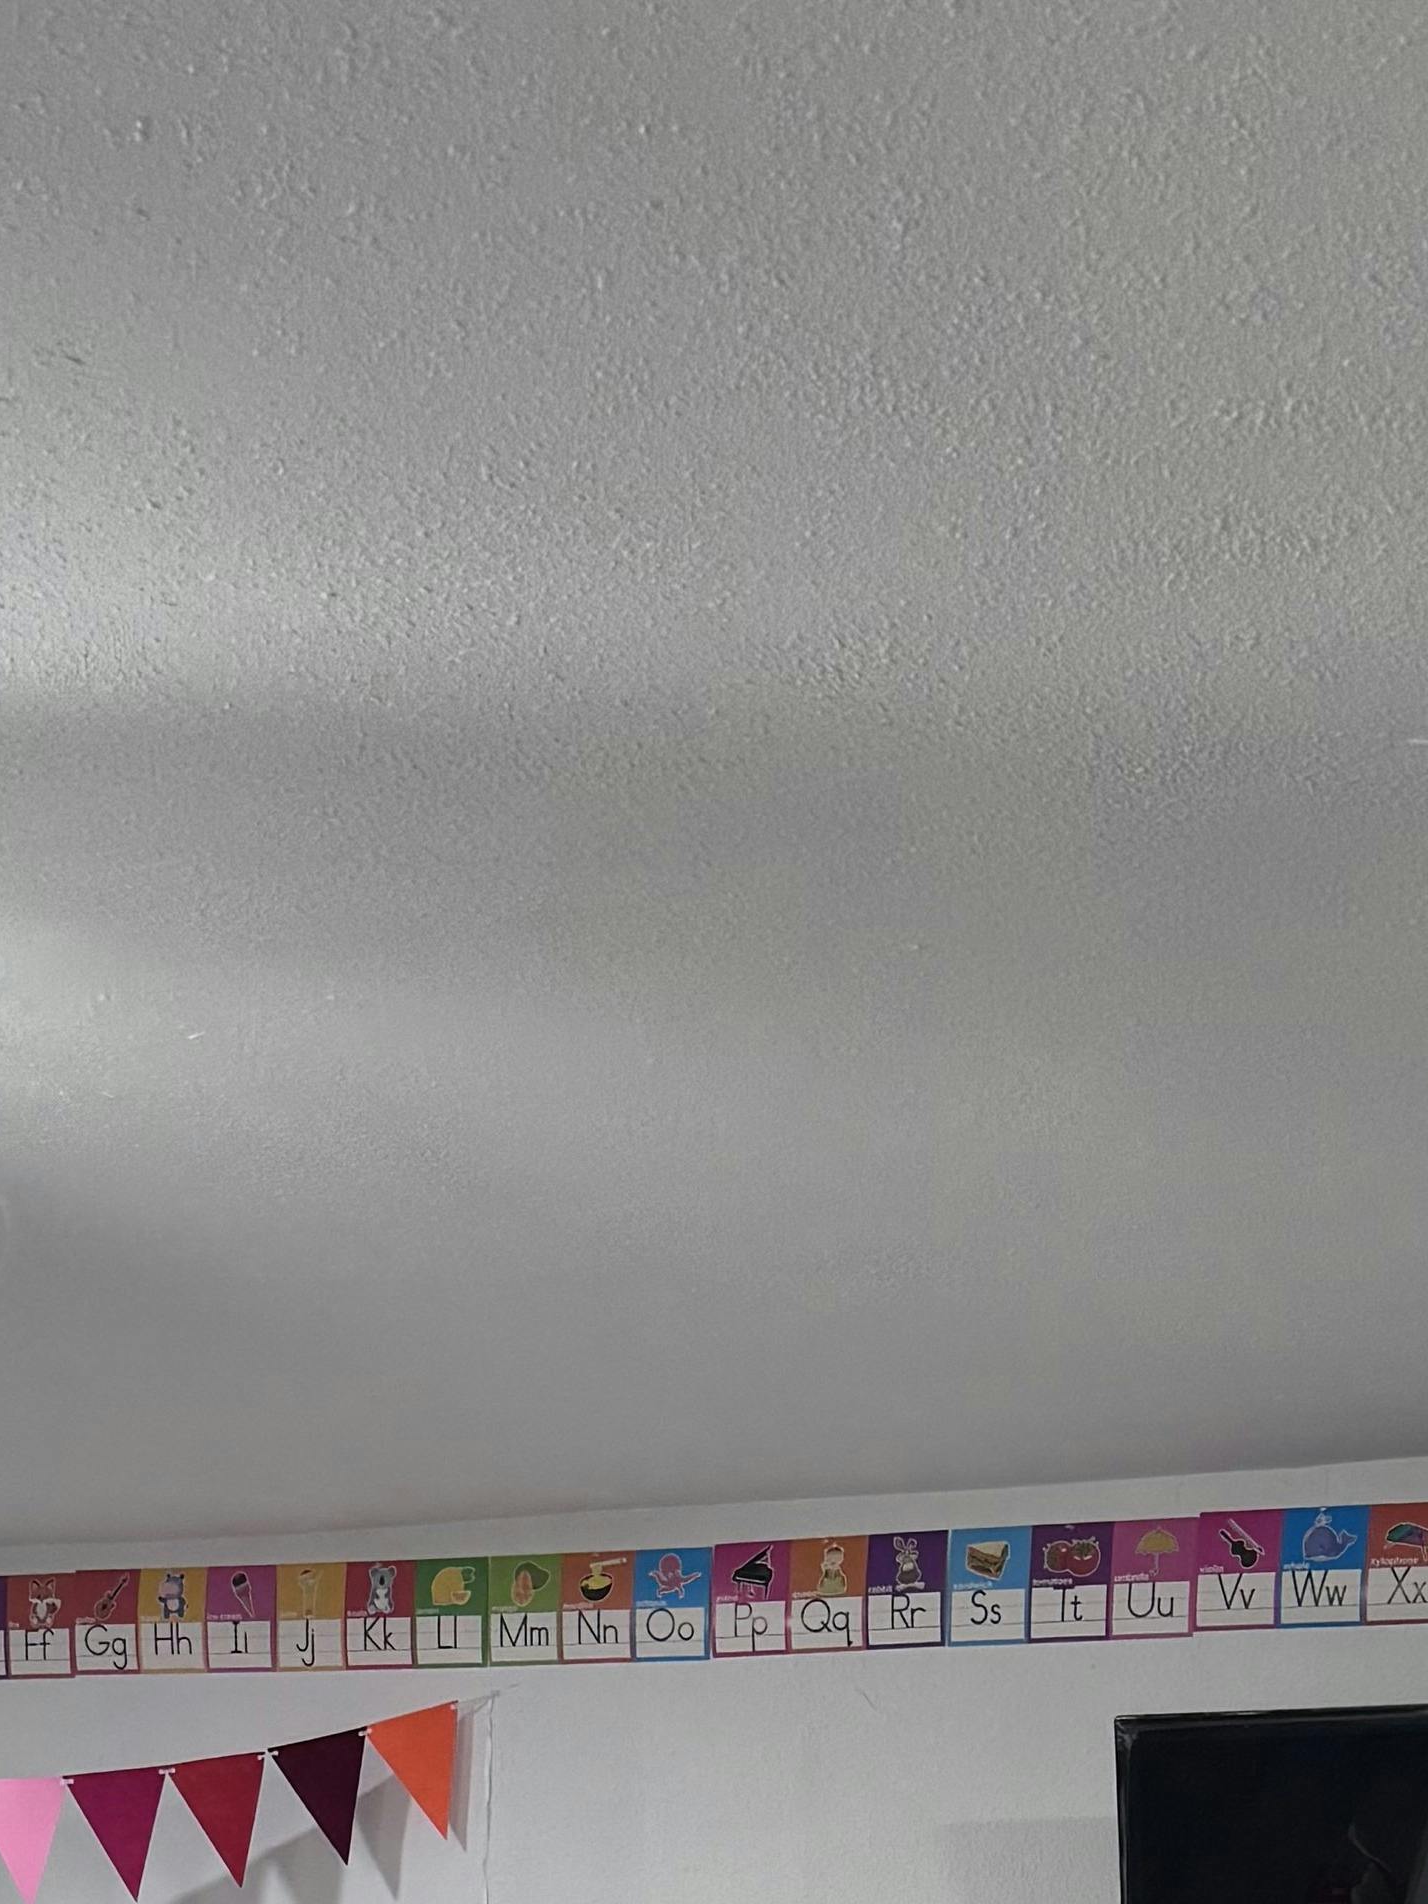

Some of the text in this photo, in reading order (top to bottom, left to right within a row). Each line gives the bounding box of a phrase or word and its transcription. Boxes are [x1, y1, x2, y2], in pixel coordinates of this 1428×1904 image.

[1127, 1581, 1174, 1619] Uu
[1217, 1572, 1256, 1610] Vv
[1291, 1569, 1348, 1607] Ww
[1387, 1566, 1428, 1604] Xx
[800, 1598, 853, 1647] Qq
[890, 1593, 928, 1631] Rr
[970, 1589, 1003, 1626] Ss
[1053, 1586, 1084, 1623] Tt
[153, 1620, 193, 1656] Hh
[295, 1618, 316, 1667] Jj
[362, 1614, 396, 1651] Kk
[499, 1608, 550, 1648] Mm
[577, 1607, 619, 1645] Nn
[645, 1607, 695, 1642] Oo
[733, 1602, 768, 1650] Pp
[25, 1627, 55, 1661] Ff
[84, 1624, 128, 1670] Gg
